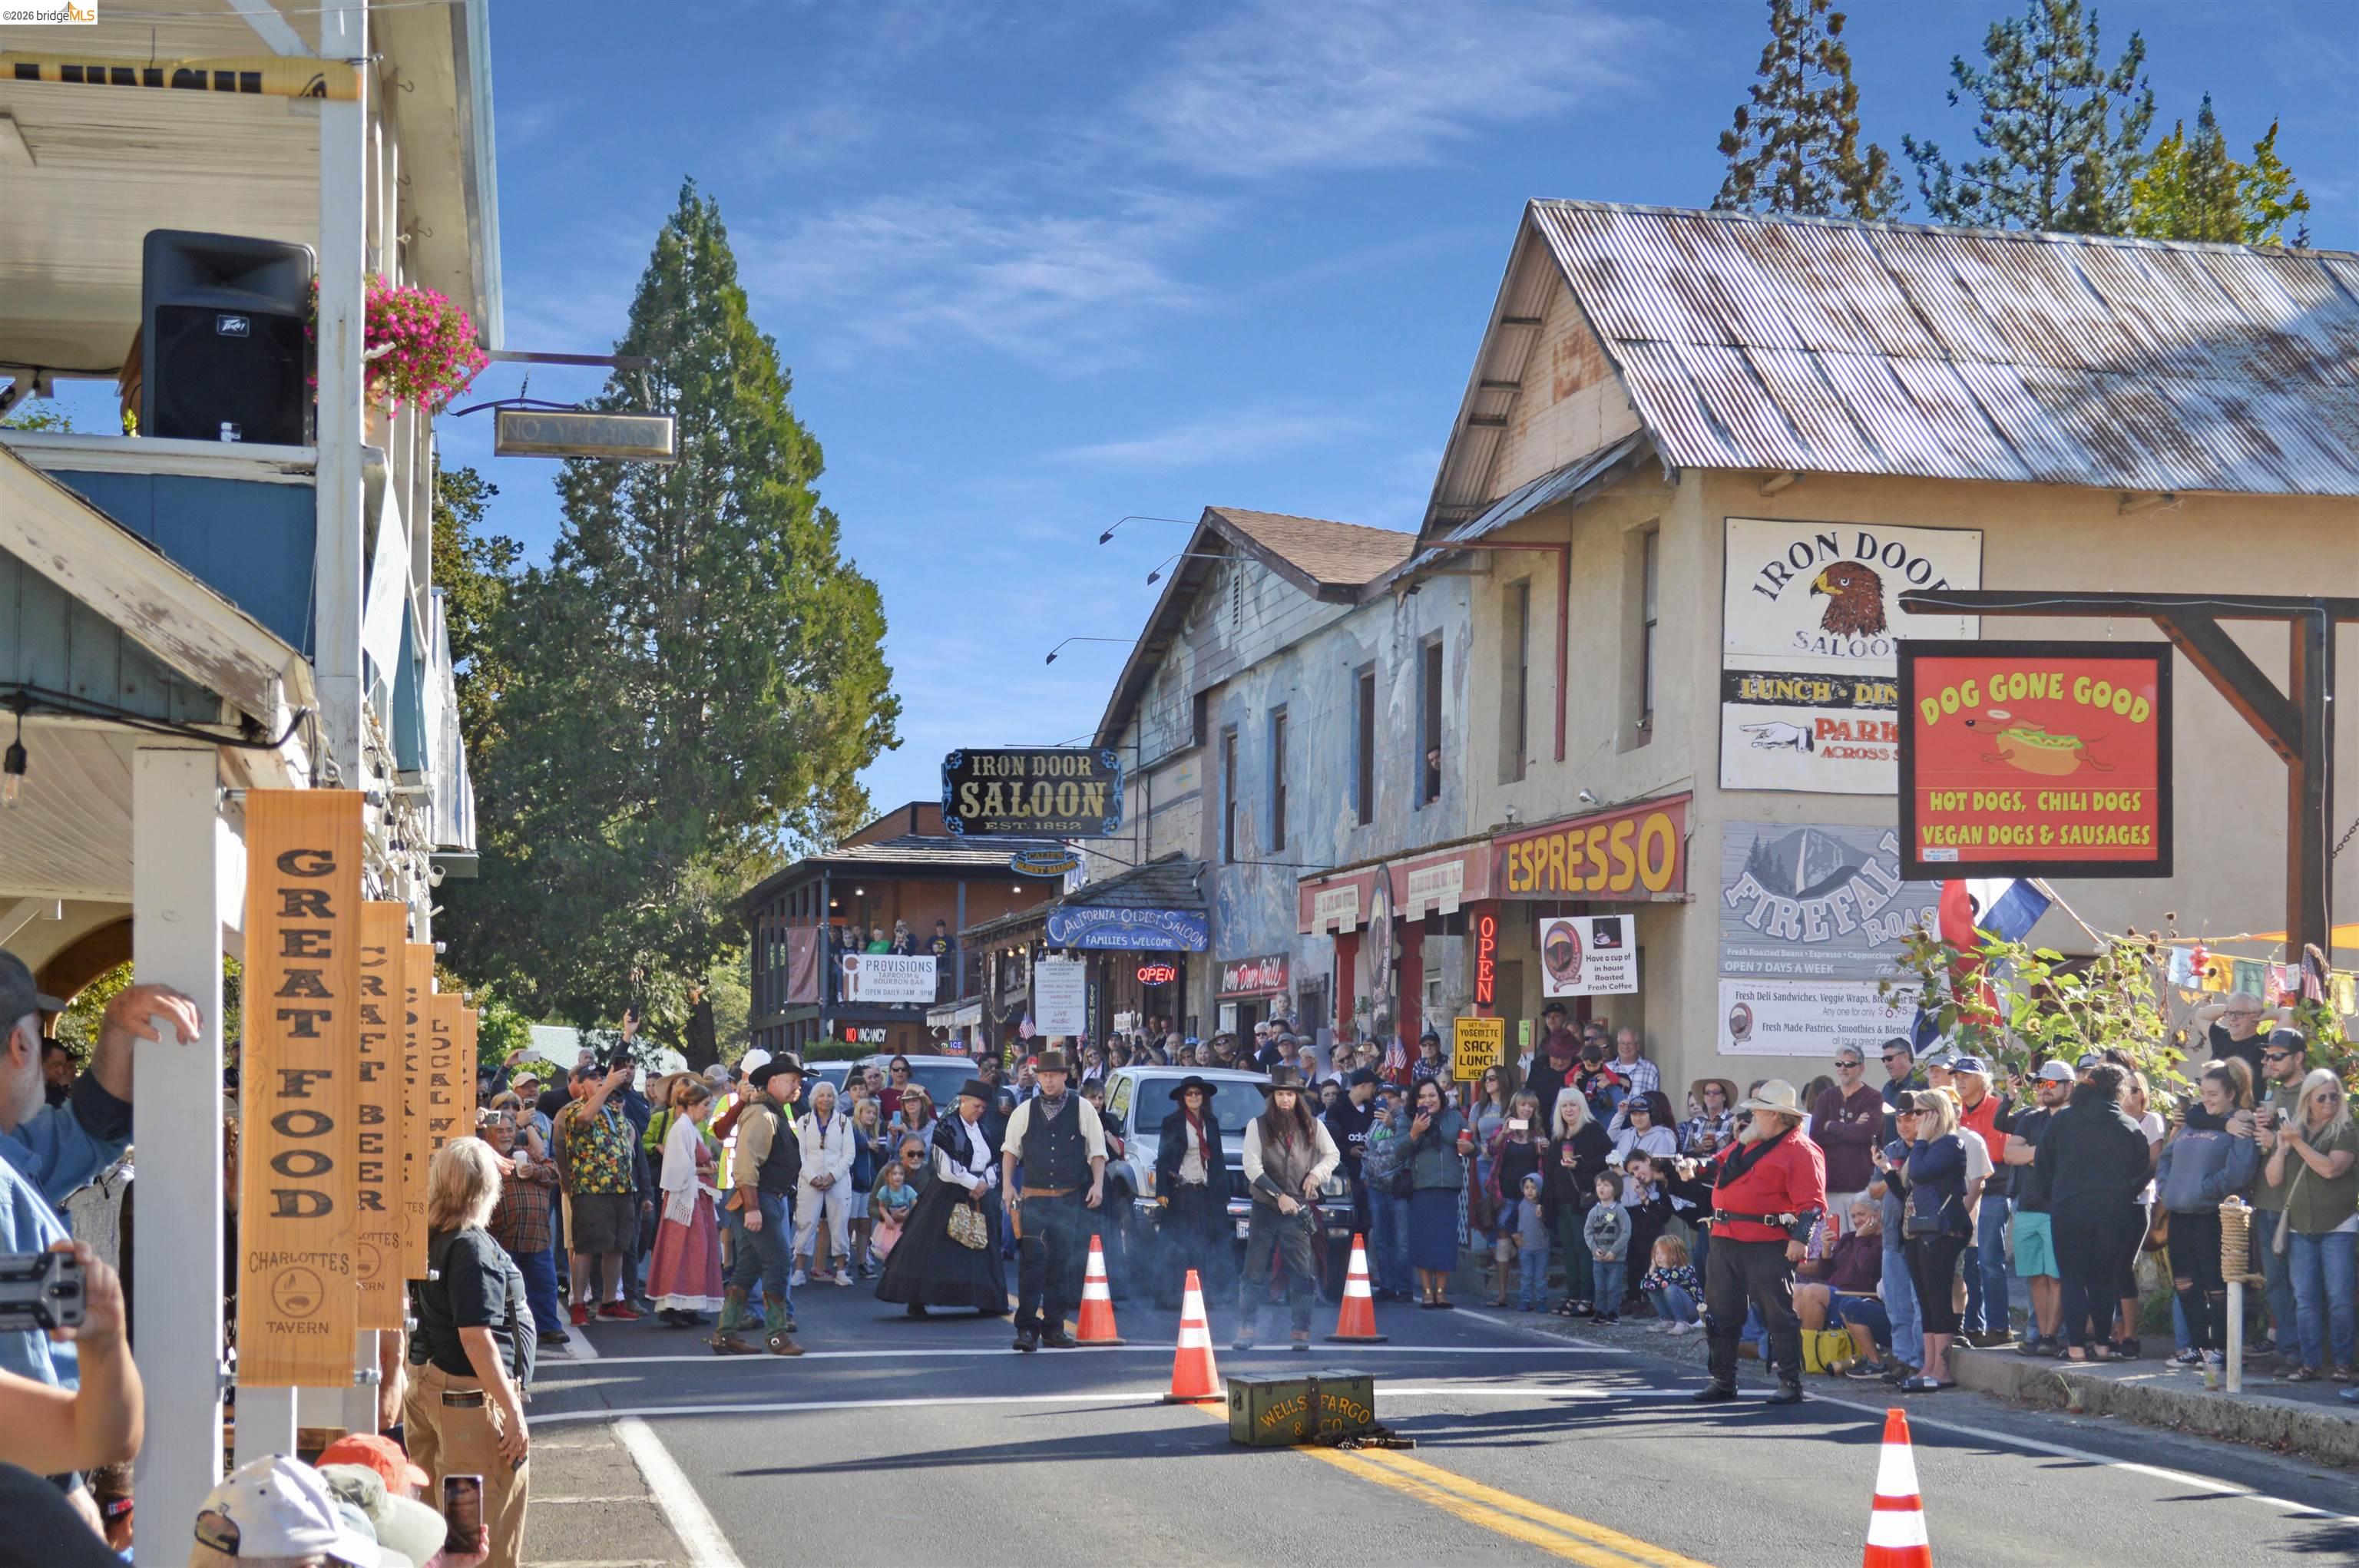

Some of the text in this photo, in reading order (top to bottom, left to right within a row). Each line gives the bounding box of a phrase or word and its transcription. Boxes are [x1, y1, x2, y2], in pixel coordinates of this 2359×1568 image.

[504, 417, 541, 440] NO
[1752, 531, 1840, 602] IRON
[1741, 678, 1897, 704] LUNCH DIN
[1920, 672, 2150, 726] DOG GONE GOOD
[1815, 717, 1898, 743] PARK
[1821, 746, 1889, 761] ACROSS
[971, 755, 1093, 777] IRON DOOR
[959, 781, 1107, 818] SALOON
[1930, 792, 2141, 812] HOT DOGS, CHILI DOGS
[984, 822, 1081, 830] EST. 1852
[1921, 825, 2150, 845] VEGAN DOGS & SAUSAGES
[1509, 812, 1676, 892] ESPRESSO
[1048, 908, 1207, 948] CALIFORNIA OLDEST SALOON
[273, 849, 336, 1037] GREAT
[1086, 935, 1173, 947] FAMILIES WELCOME
[1477, 917, 1494, 1002] OPEN
[1727, 948, 1747, 956] Fresh
[1749, 948, 1779, 957] Roasted
[1848, 951, 1891, 960] Cappuccino
[866, 960, 932, 972] PROVISIONS
[1137, 968, 1175, 981] OPEN
[1725, 962, 1834, 974] OPEN 7 DAYS A WEEK
[1239, 964, 1258, 990] Door
[1735, 991, 1755, 1000] Fresh
[1757, 991, 1771, 1001] Deli
[1820, 993, 1845, 1004] Veggie
[1823, 1007, 1835, 1017] Any
[1861, 1007, 1874, 1017] only
[846, 1028, 886, 1043] NO VACANCY
[1460, 1029, 1499, 1037] YOSEMITE
[1762, 1023, 1781, 1031] Fresh
[1784, 1023, 1802, 1032] Made
[1838, 1024, 1875, 1034] Smoothies
[1885, 1026, 1911, 1034] Blende
[1464, 1040, 1494, 1053] SACK
[1858, 1037, 1876, 1046] great
[1459, 1055, 1498, 1067] LUNCH
[270, 1069, 334, 1218] FOOD
[359, 1104, 385, 1210] BEER
[249, 1252, 349, 1275] CHARLOTTE'S
[266, 1321, 329, 1334] TAVERN
[1260, 1394, 1370, 1427] WELLS FARGO
[1294, 1421, 1302, 1436] &
